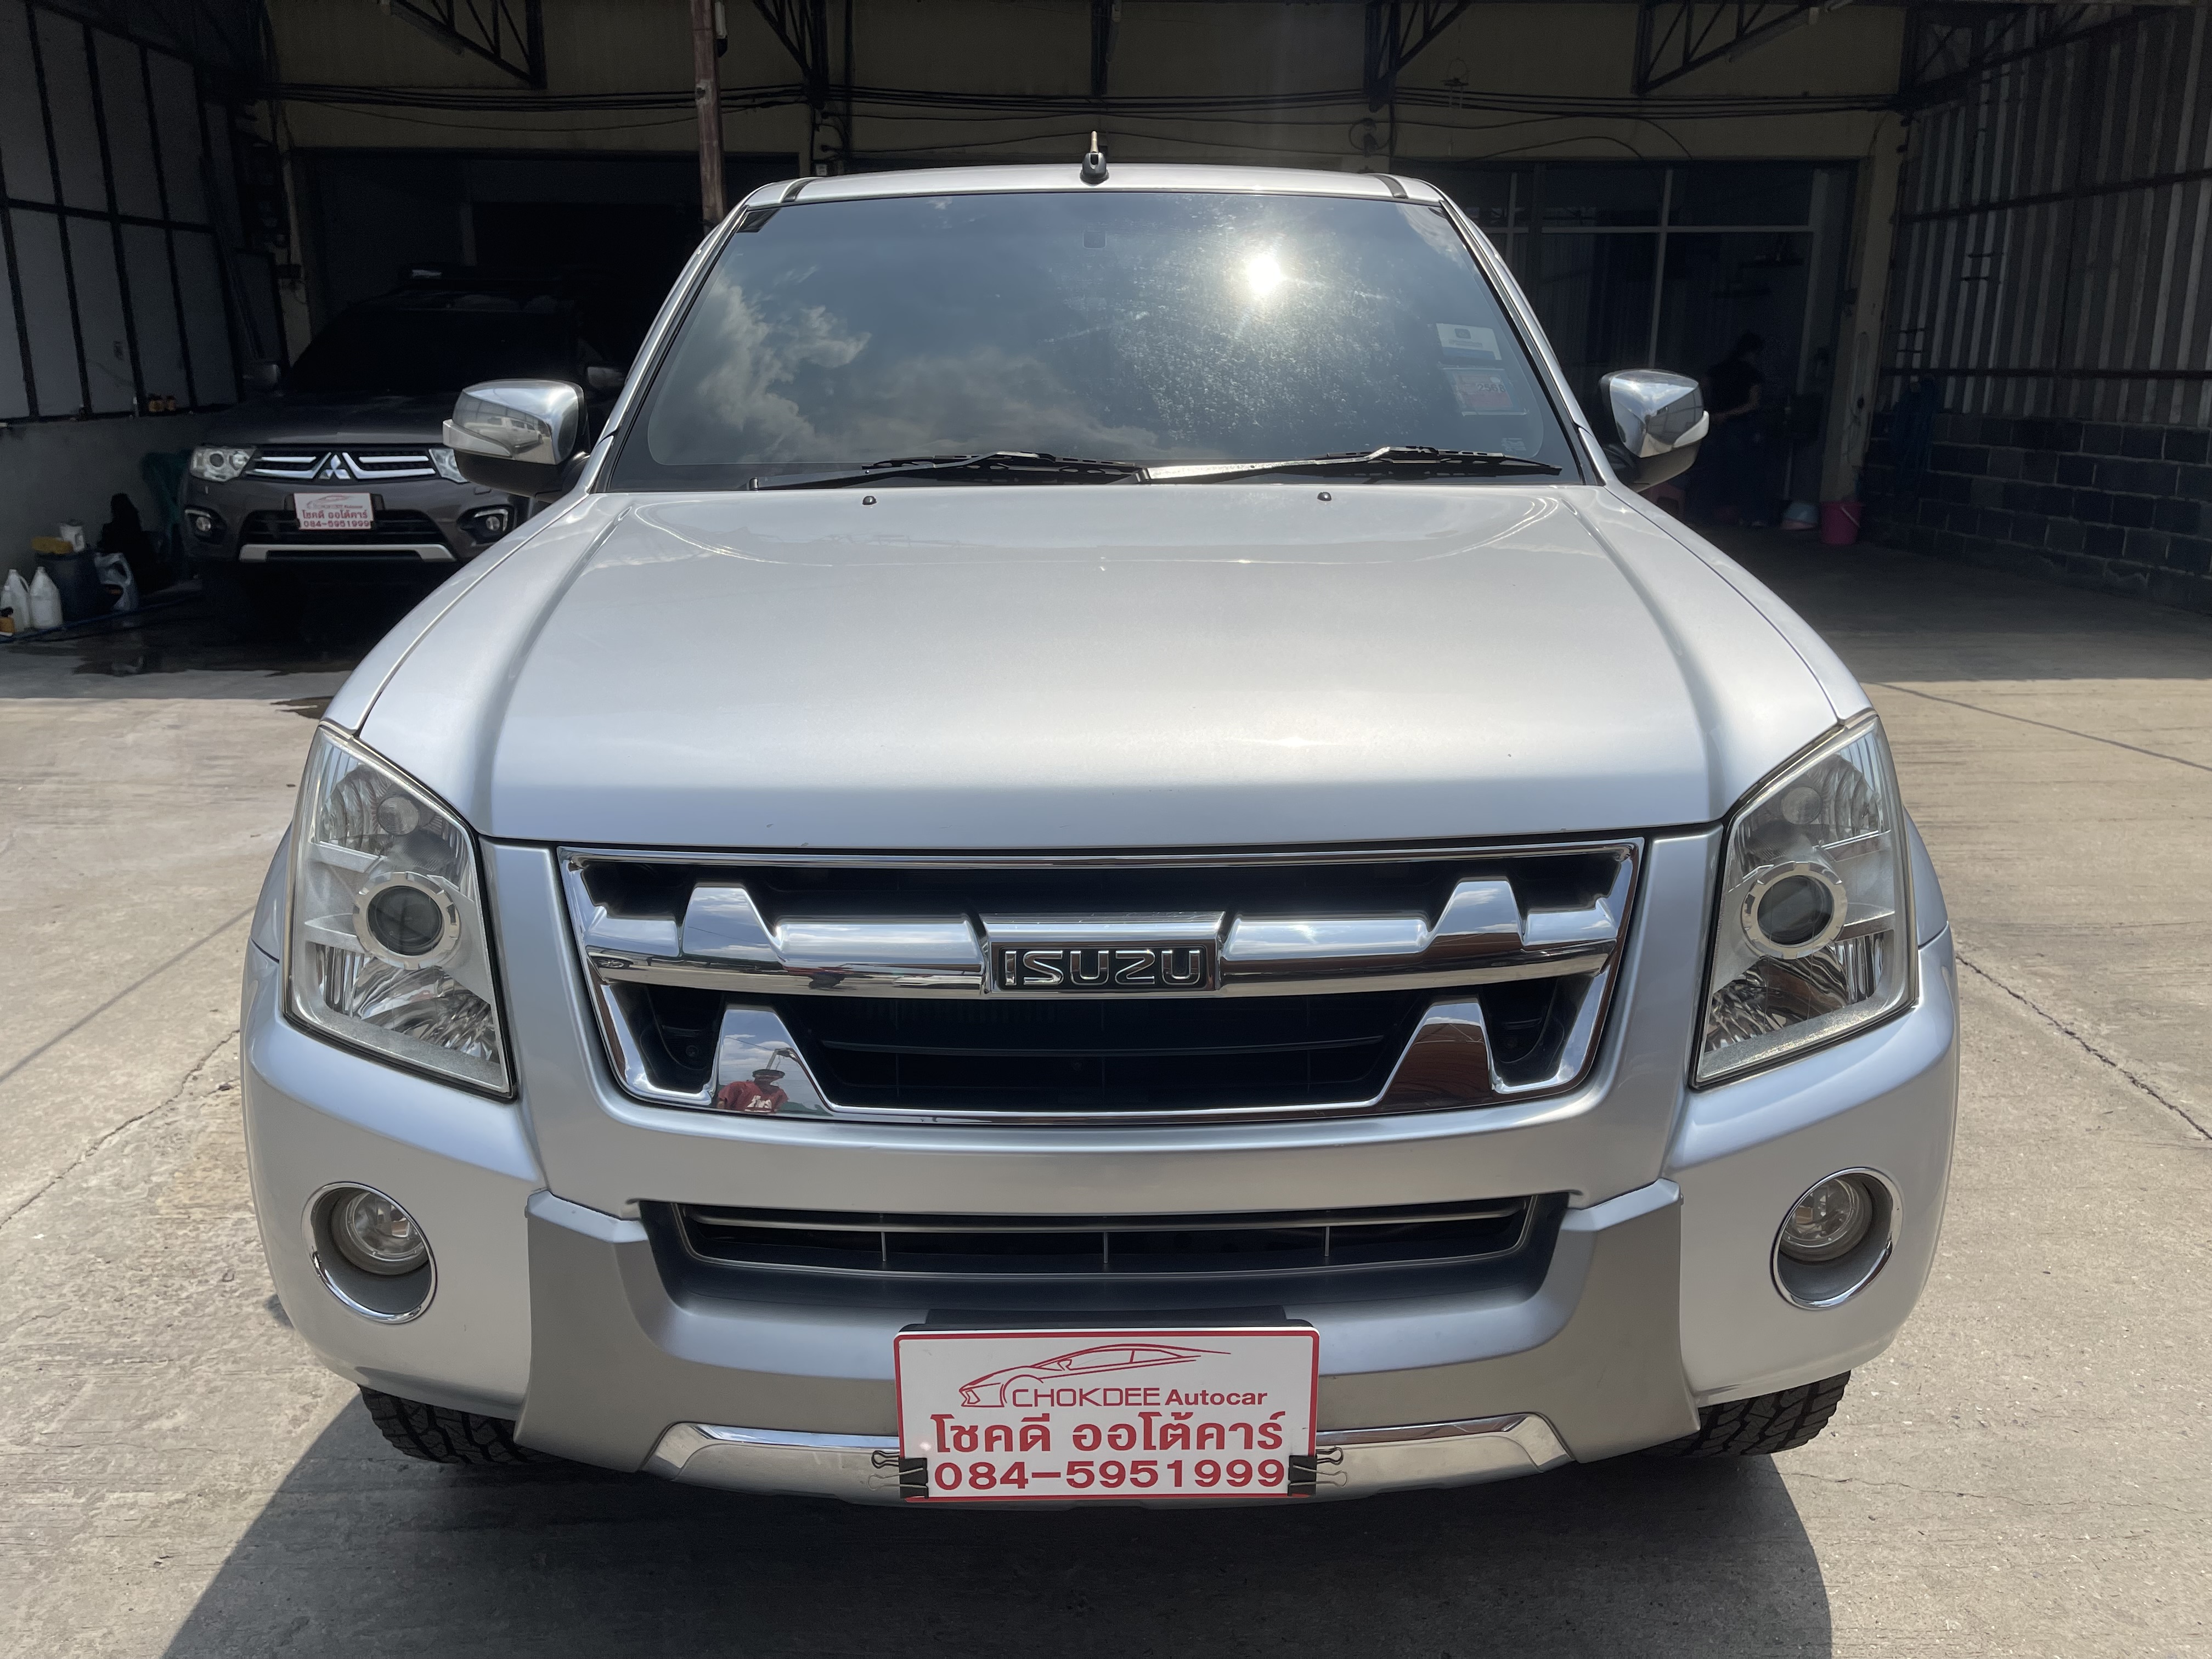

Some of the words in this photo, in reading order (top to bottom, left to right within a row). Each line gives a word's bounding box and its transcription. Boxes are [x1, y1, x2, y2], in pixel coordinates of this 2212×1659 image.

[1477, 383, 1506, 392] 2568
[1005, 950, 1201, 986] ISUZU
[1012, 1387, 1161, 1408] CHOKDEE
[1164, 1389, 1268, 1406] Autocar
[930, 1413, 1051, 1453] โชคดี
[1072, 1410, 1286, 1452] ออโต้คาร์
[934, 1459, 1285, 1491] 084-5951999
